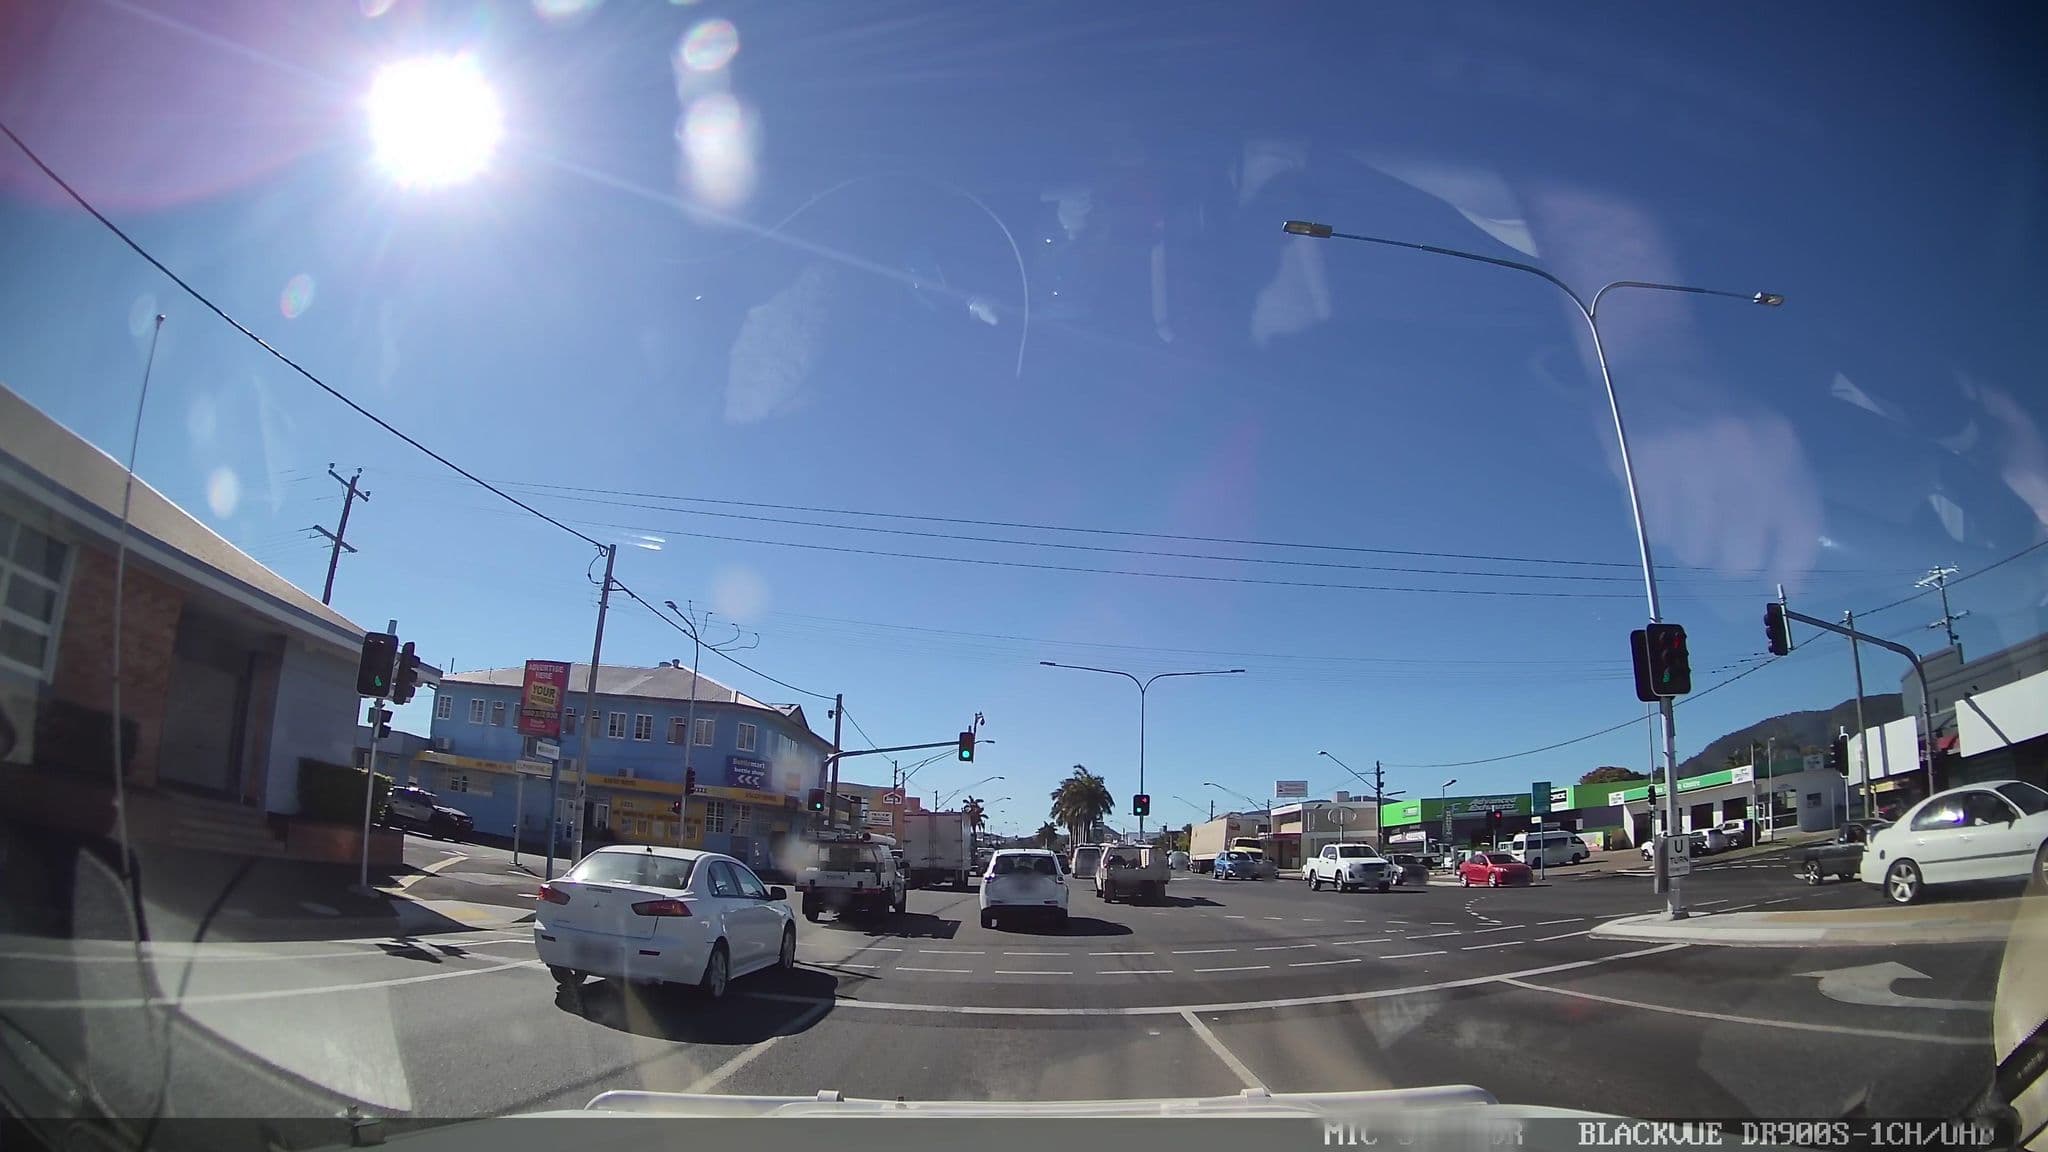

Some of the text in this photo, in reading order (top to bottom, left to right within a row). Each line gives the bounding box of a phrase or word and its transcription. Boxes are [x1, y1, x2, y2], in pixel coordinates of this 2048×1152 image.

[529, 663, 565, 674] ADVERTISE
[535, 672, 553, 681] HERE
[533, 685, 556, 699] YOUR
[1674, 839, 1683, 854] U
[1669, 855, 1689, 865] TURN
